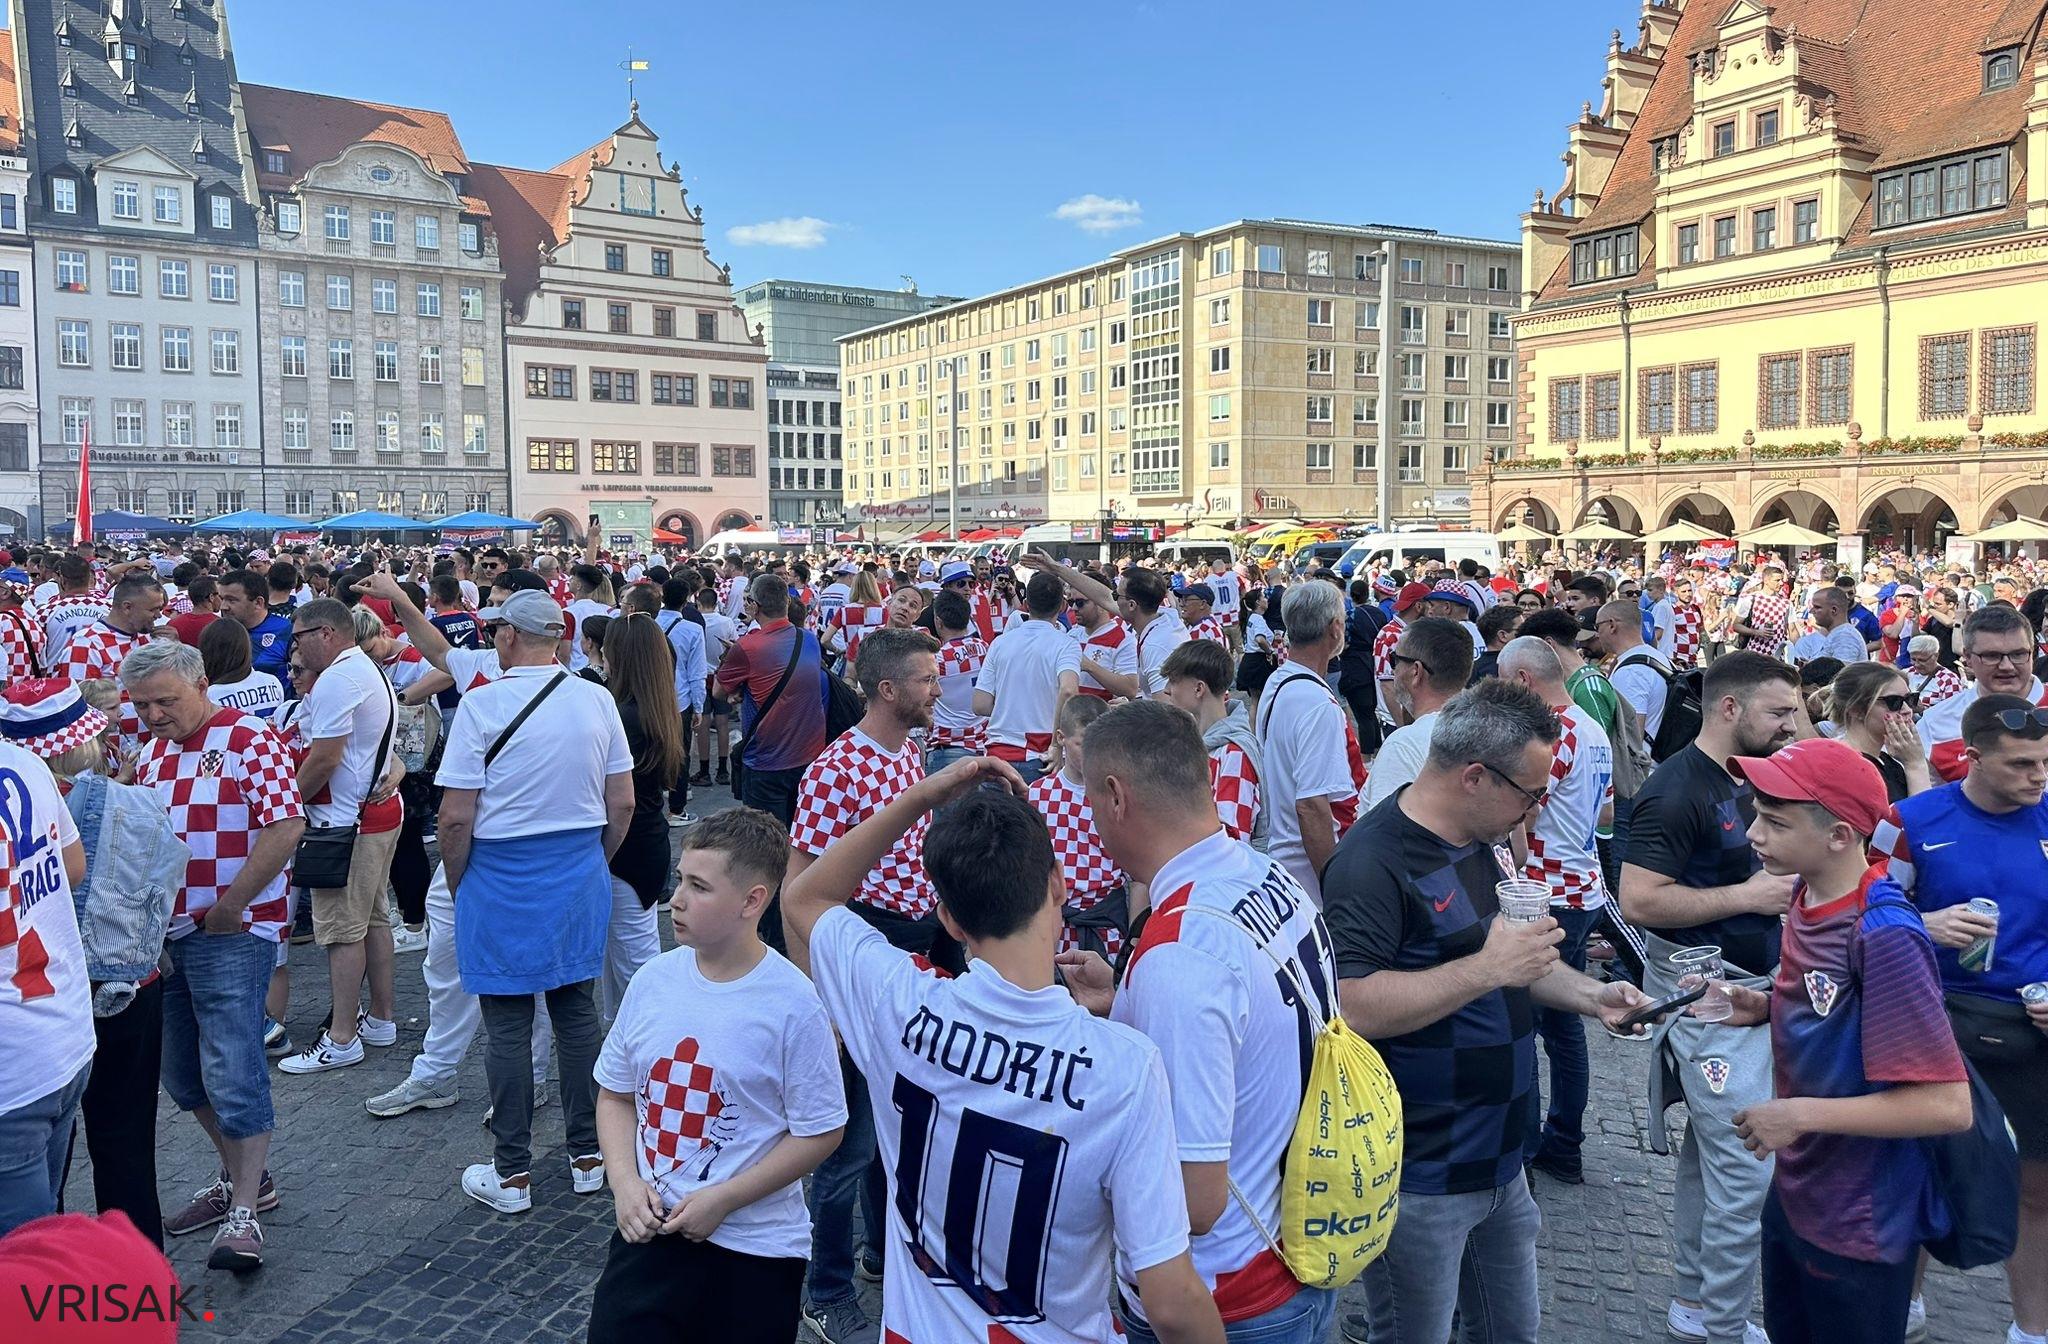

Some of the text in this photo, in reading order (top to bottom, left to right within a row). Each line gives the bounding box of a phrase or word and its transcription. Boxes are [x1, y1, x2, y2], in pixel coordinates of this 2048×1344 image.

[770, 286, 786, 298] der
[790, 286, 838, 303] bildenden
[842, 292, 875, 307] Künste
[1522, 324, 1550, 336] NACH
[1589, 311, 1636, 327] UNSES
[1640, 304, 1678, 319] HERRN
[1682, 297, 1732, 312] GEBURTH
[1738, 293, 1752, 304] IM
[1842, 276, 1864, 289] BEY
[1966, 256, 1994, 270] DES
[89, 450, 220, 463] Augustiner am Markt
[1770, 469, 1820, 479] BRASSERIE
[1872, 464, 1944, 476] RESTAURANT
[645, 485, 713, 493] VERSICHERUNGEN
[1204, 488, 1231, 515] STEIN
[1254, 487, 1288, 513] STEIN
[1218, 586, 1230, 605] 10
[55, 608, 105, 624] MANDŽUKI
[218, 682, 280, 709] MODRIĆ
[19, 849, 61, 920] RAČ
[901, 1005, 1093, 1112] MODRIĆ
[1320, 1089, 1332, 1139] doka
[892, 1071, 1070, 1325] 10
[1304, 1211, 1371, 1237] oka
